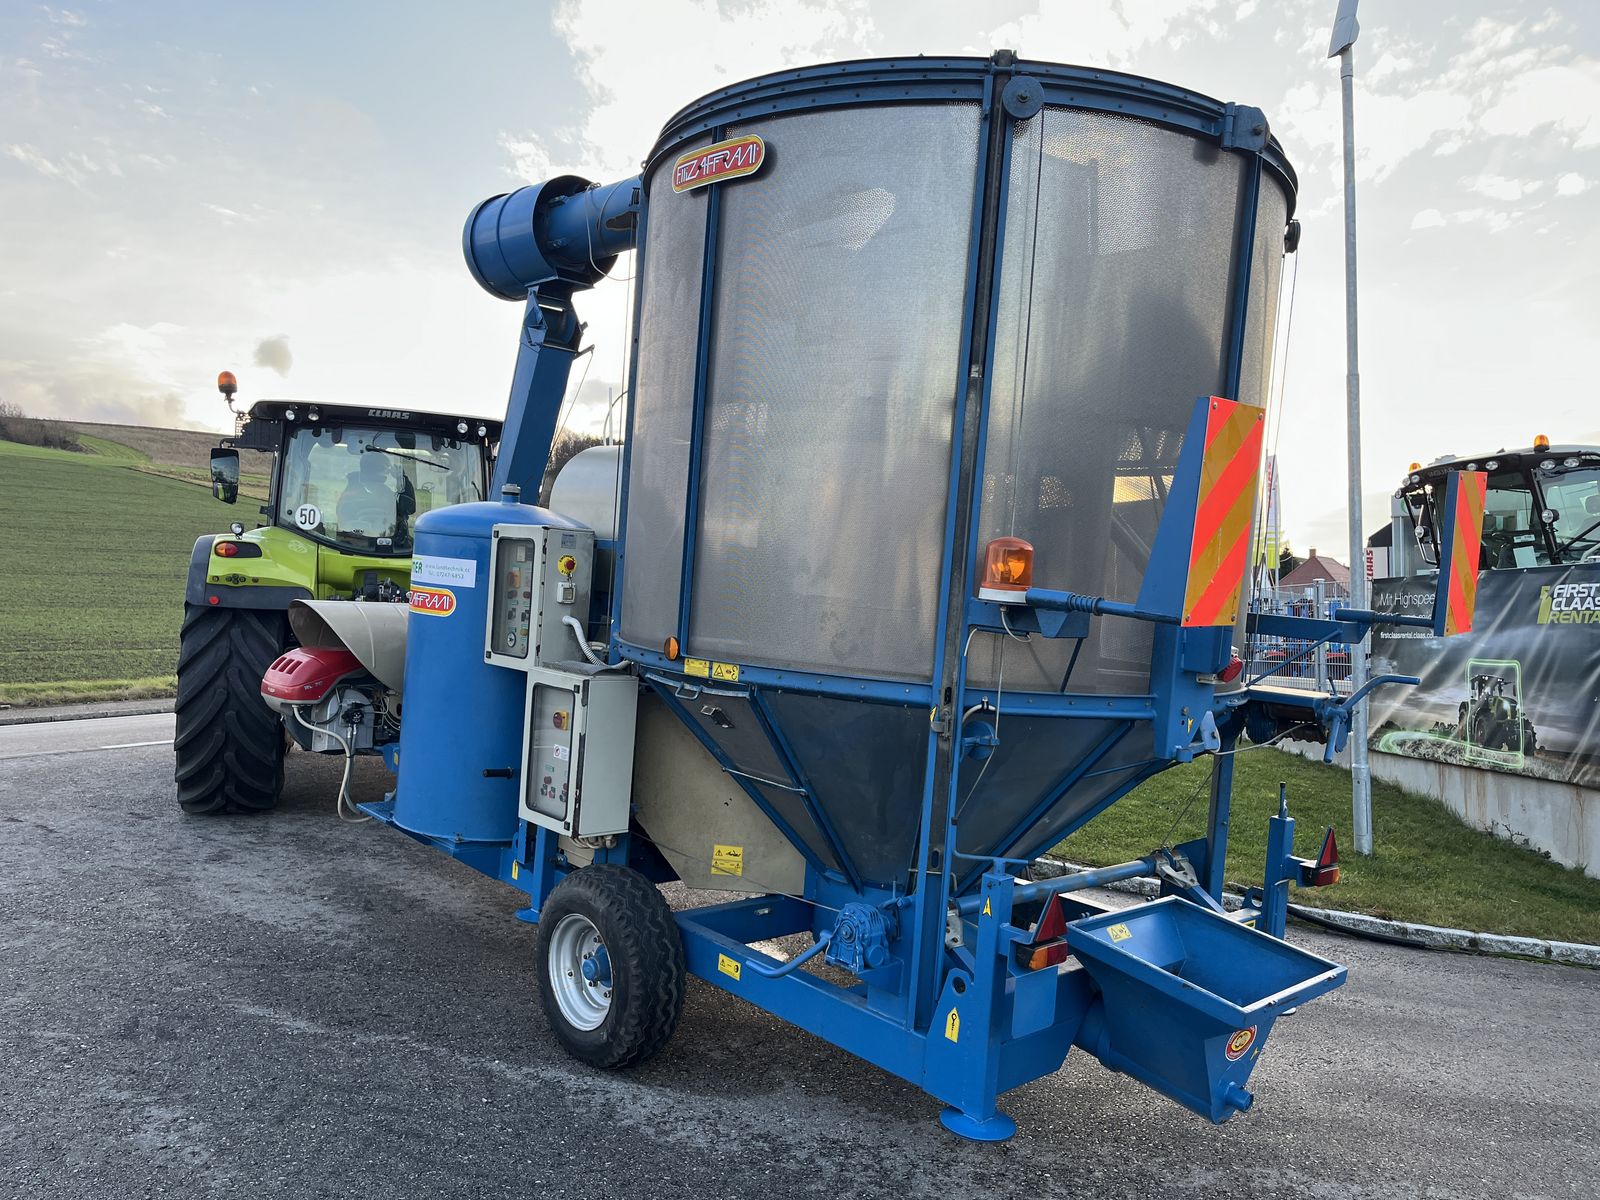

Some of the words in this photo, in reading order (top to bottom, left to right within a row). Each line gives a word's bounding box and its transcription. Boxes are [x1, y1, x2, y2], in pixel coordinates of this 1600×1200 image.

[368, 409, 410, 420] CLAAS
[300, 508, 316, 525] 50
[1553, 583, 1600, 598] FIRST
[1394, 591, 1436, 609] Highspee
